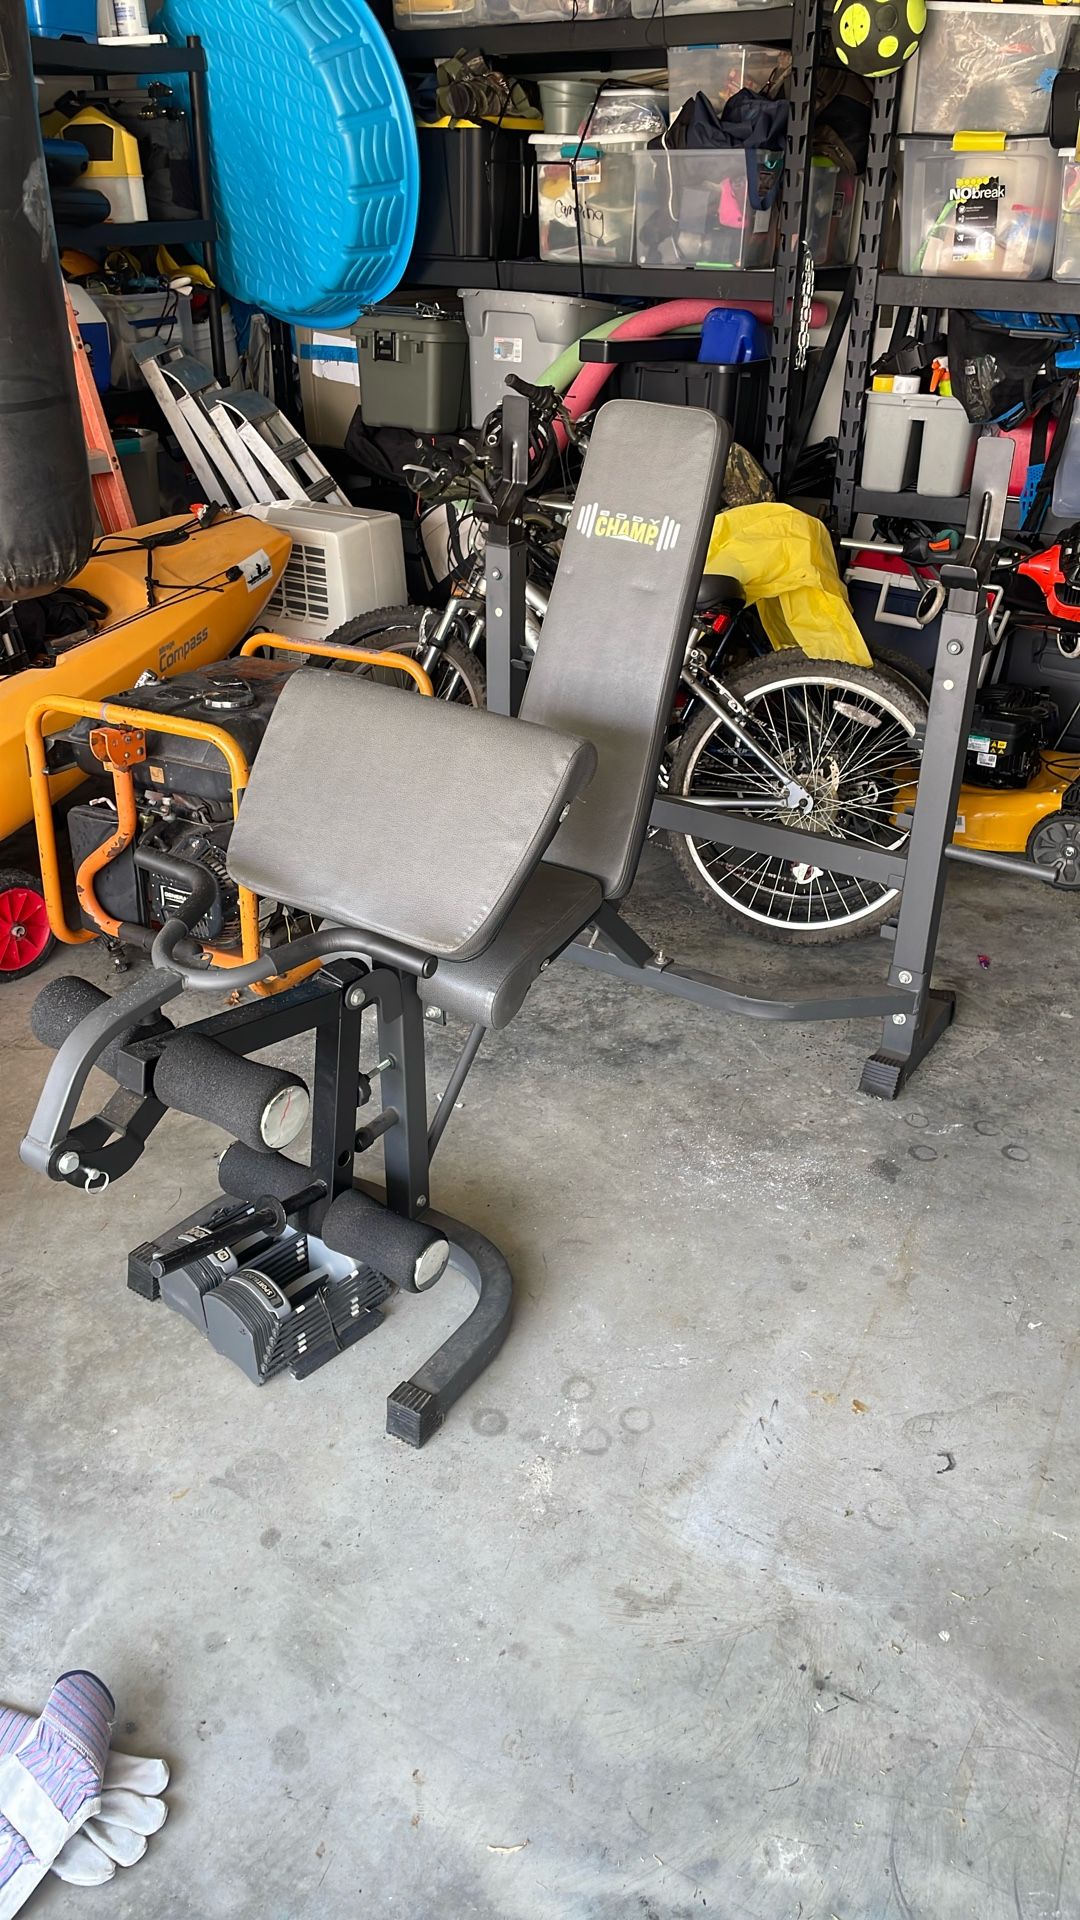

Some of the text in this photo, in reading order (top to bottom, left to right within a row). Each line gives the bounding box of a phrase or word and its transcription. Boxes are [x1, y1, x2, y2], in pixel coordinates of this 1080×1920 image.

[949, 185, 1005, 201] NObreak
[599, 510, 660, 524] BODY
[159, 627, 209, 673] Compass
